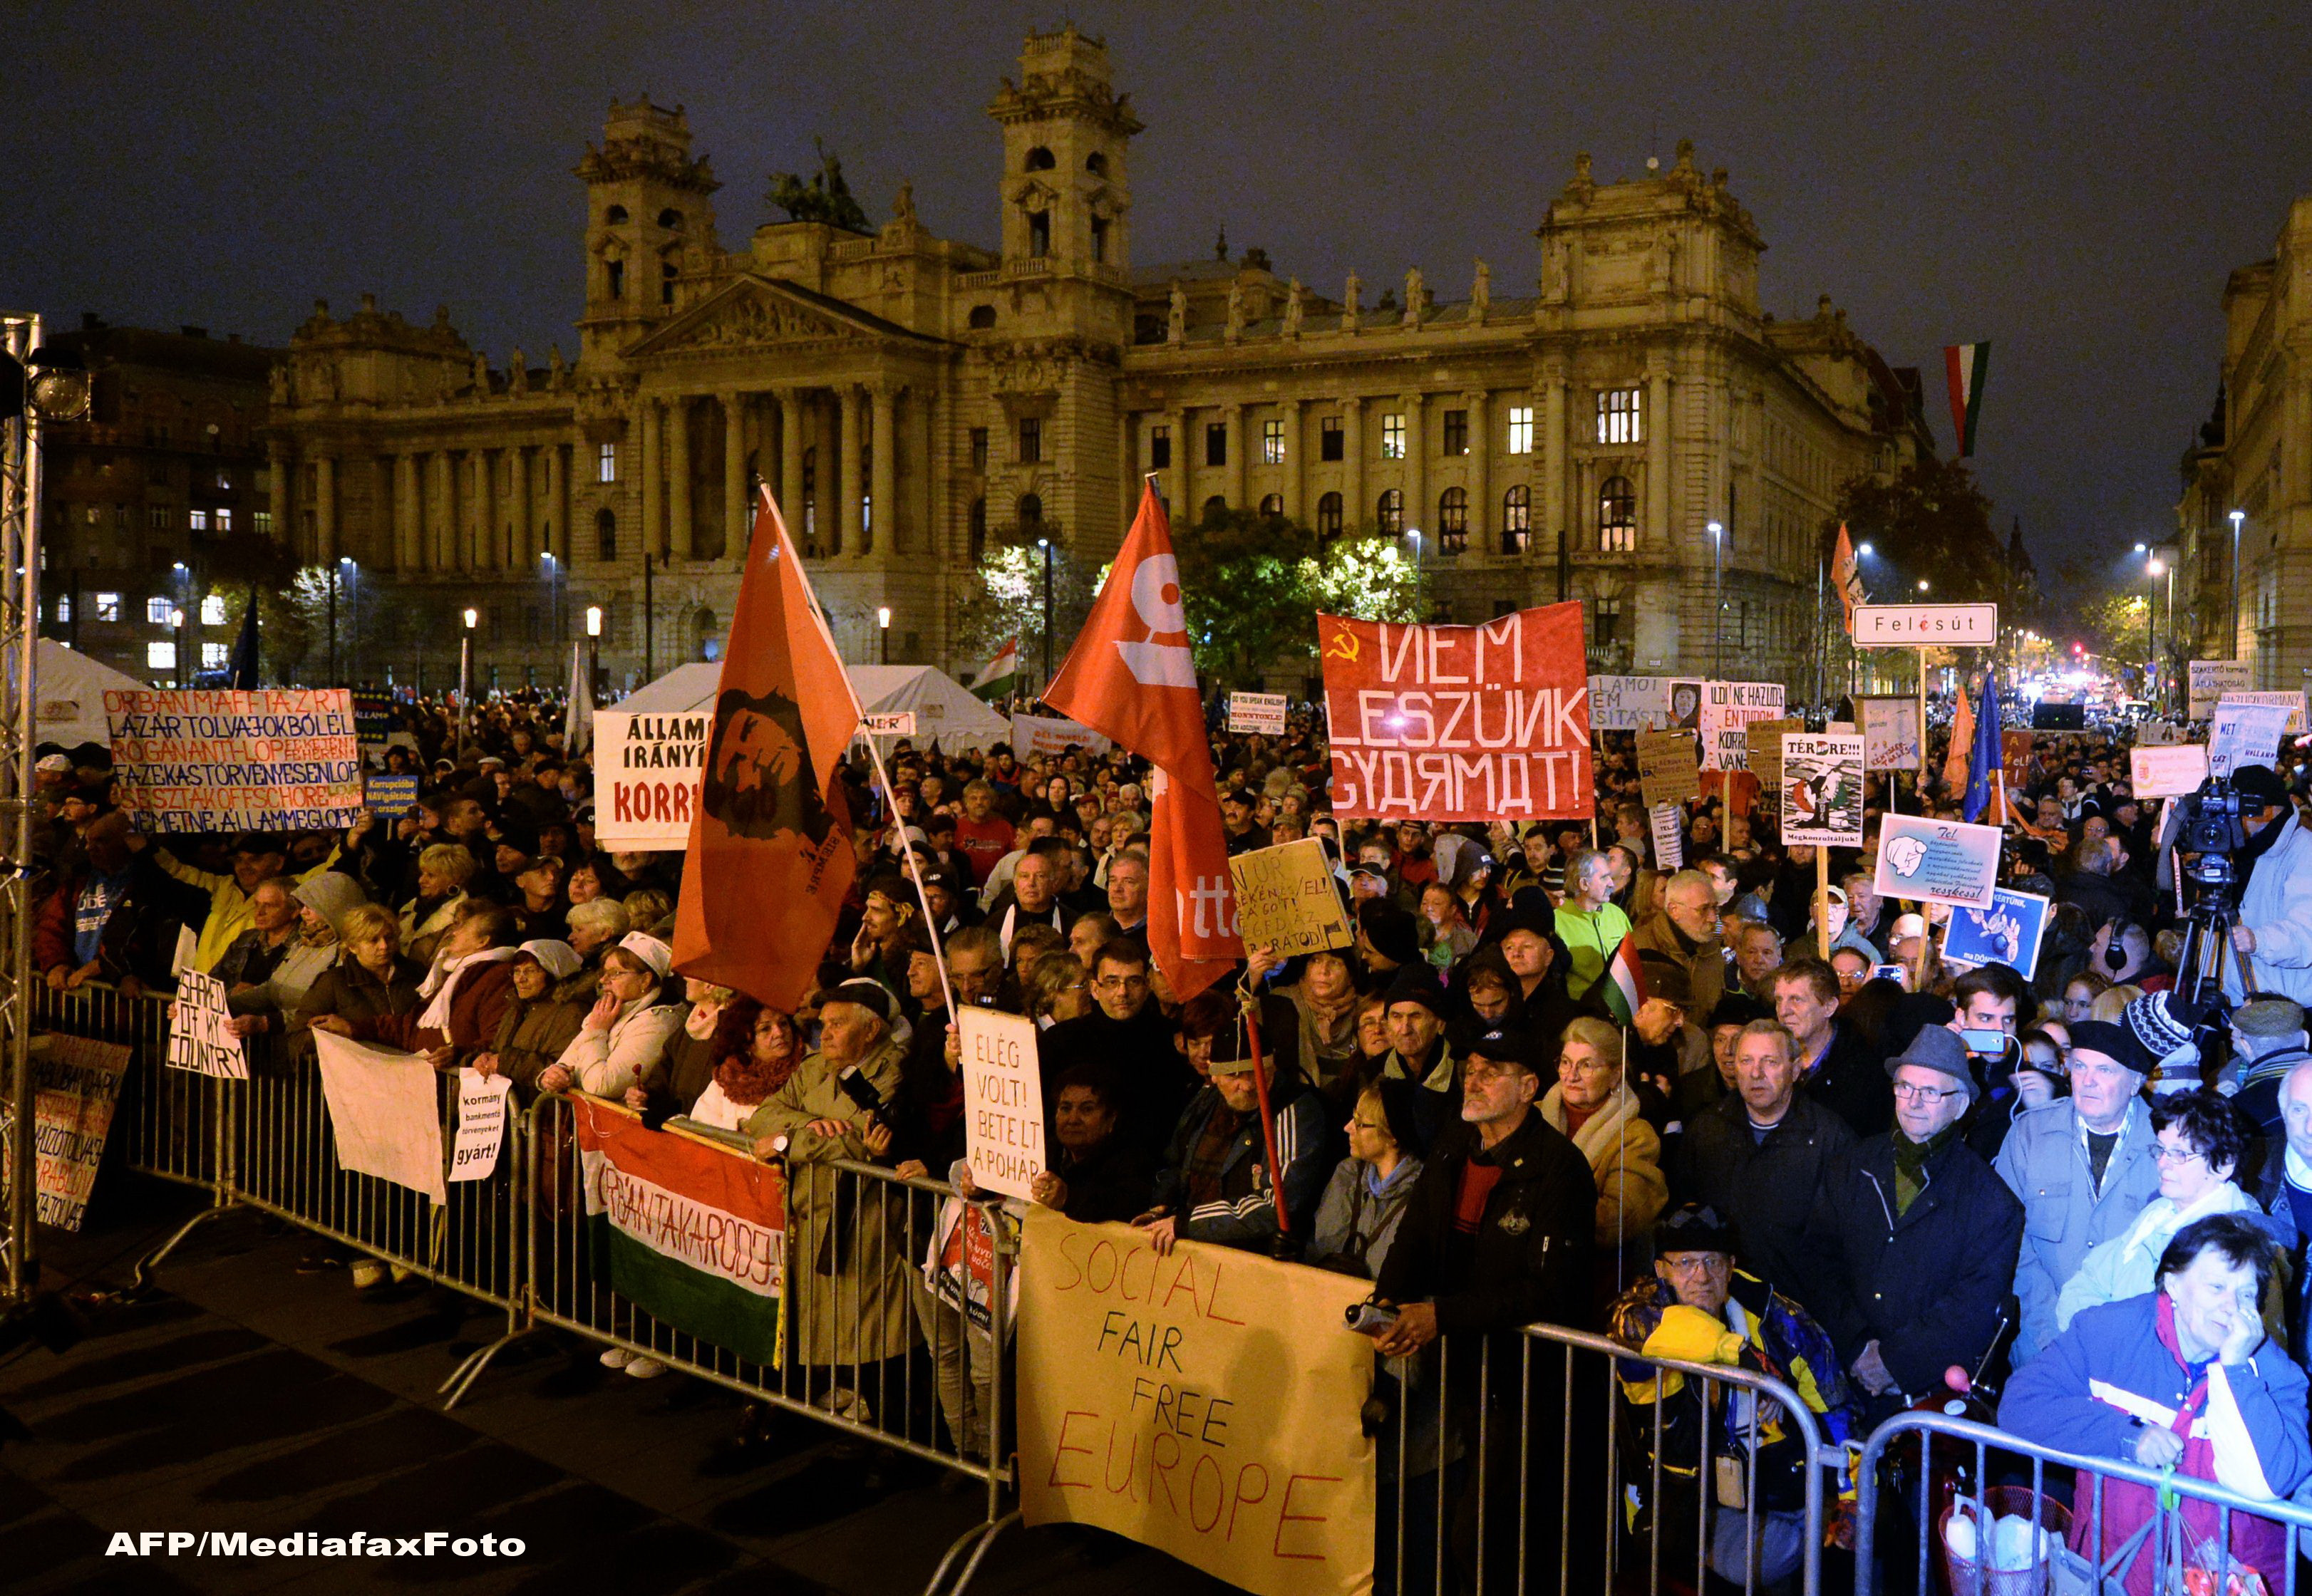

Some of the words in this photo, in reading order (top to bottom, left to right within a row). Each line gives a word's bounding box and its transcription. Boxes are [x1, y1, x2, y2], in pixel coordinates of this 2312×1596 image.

[167, 1034, 244, 1078] COUNTRY
[976, 1033, 1019, 1068] ELÉG
[976, 1072, 1028, 1108] VOLT!
[457, 1142, 497, 1166] gyárt!
[1056, 1233, 1246, 1326] SOCIAL
[1097, 1311, 1183, 1373] FAIR
[1130, 1377, 1234, 1448] FREE
[1048, 1411, 1343, 1560] EUROPE
